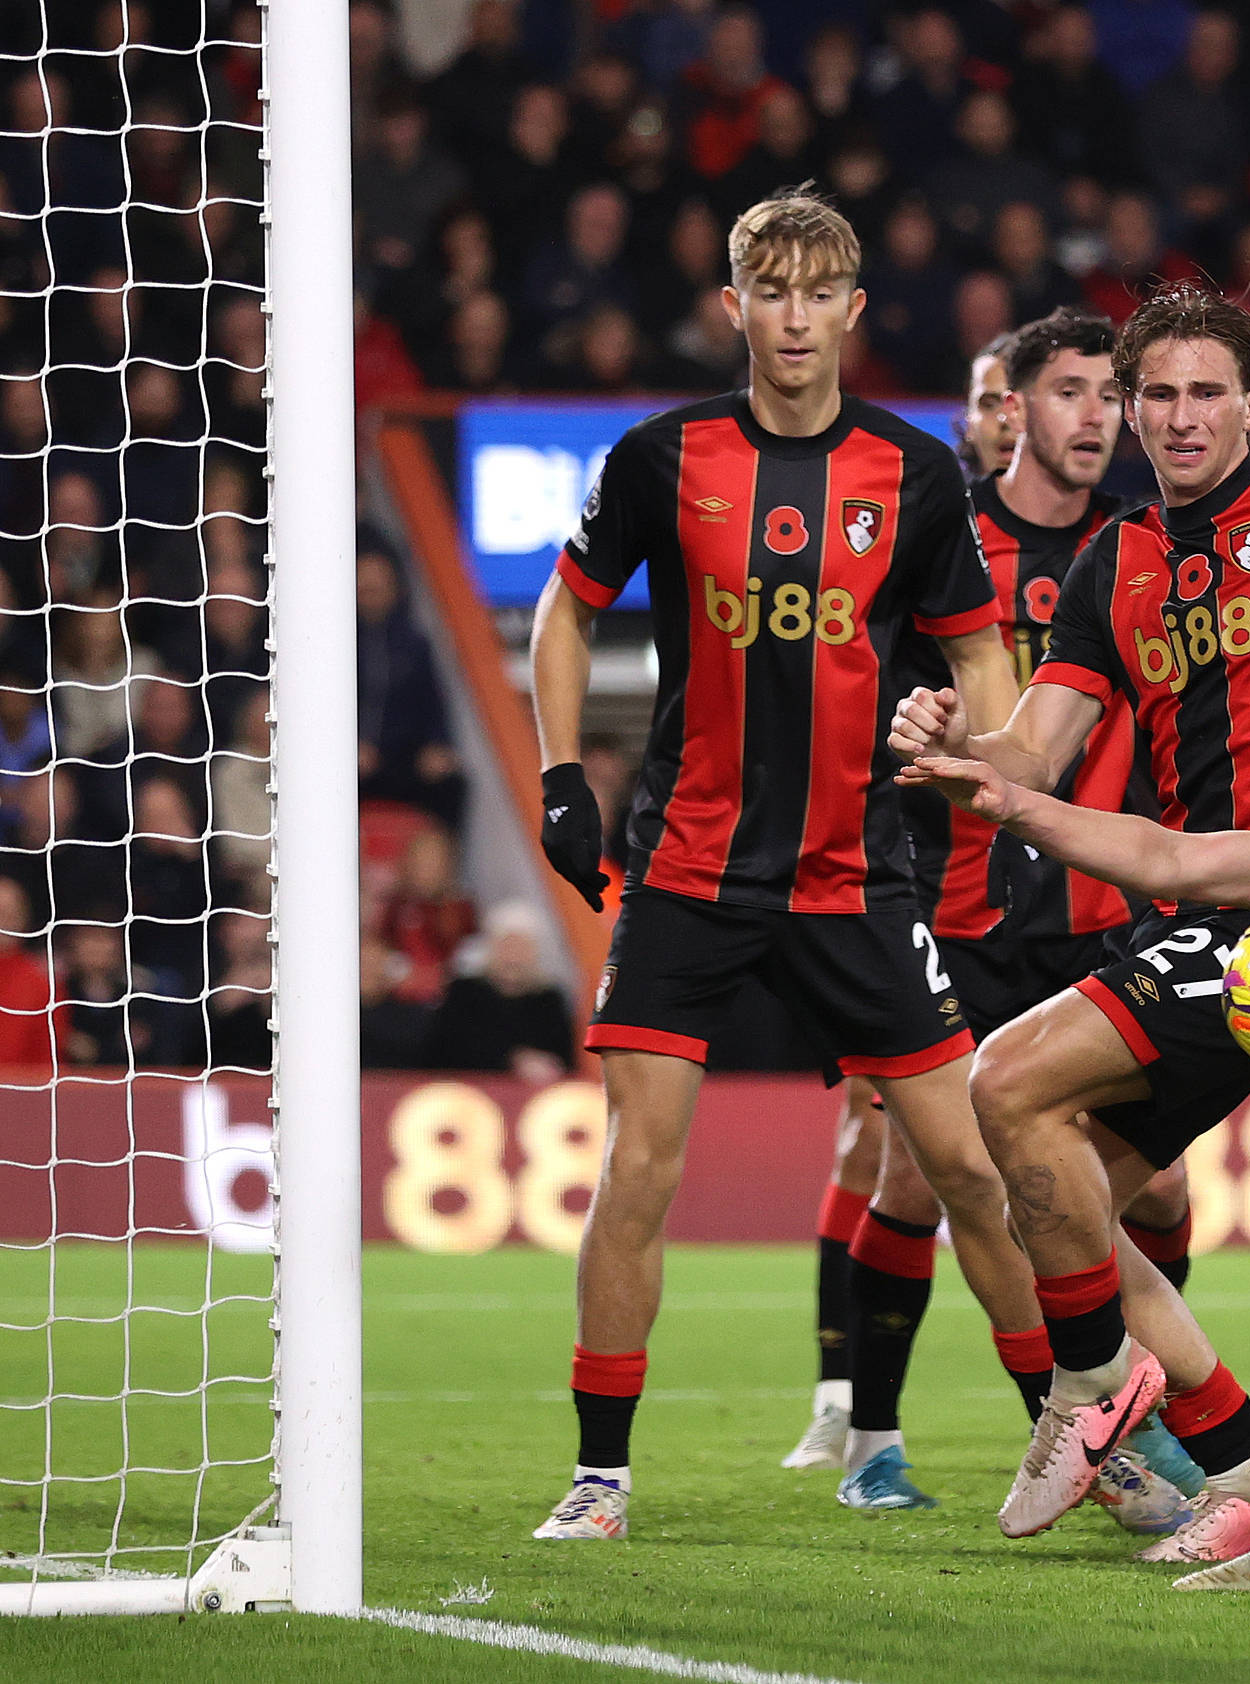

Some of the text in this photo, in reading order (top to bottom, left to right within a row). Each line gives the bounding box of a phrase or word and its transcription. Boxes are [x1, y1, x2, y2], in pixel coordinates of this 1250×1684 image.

[704, 573, 856, 650] bj88
[912, 921, 952, 995] 2
[1123, 981, 1146, 1006] umbro
[1136, 927, 1232, 999] 27
